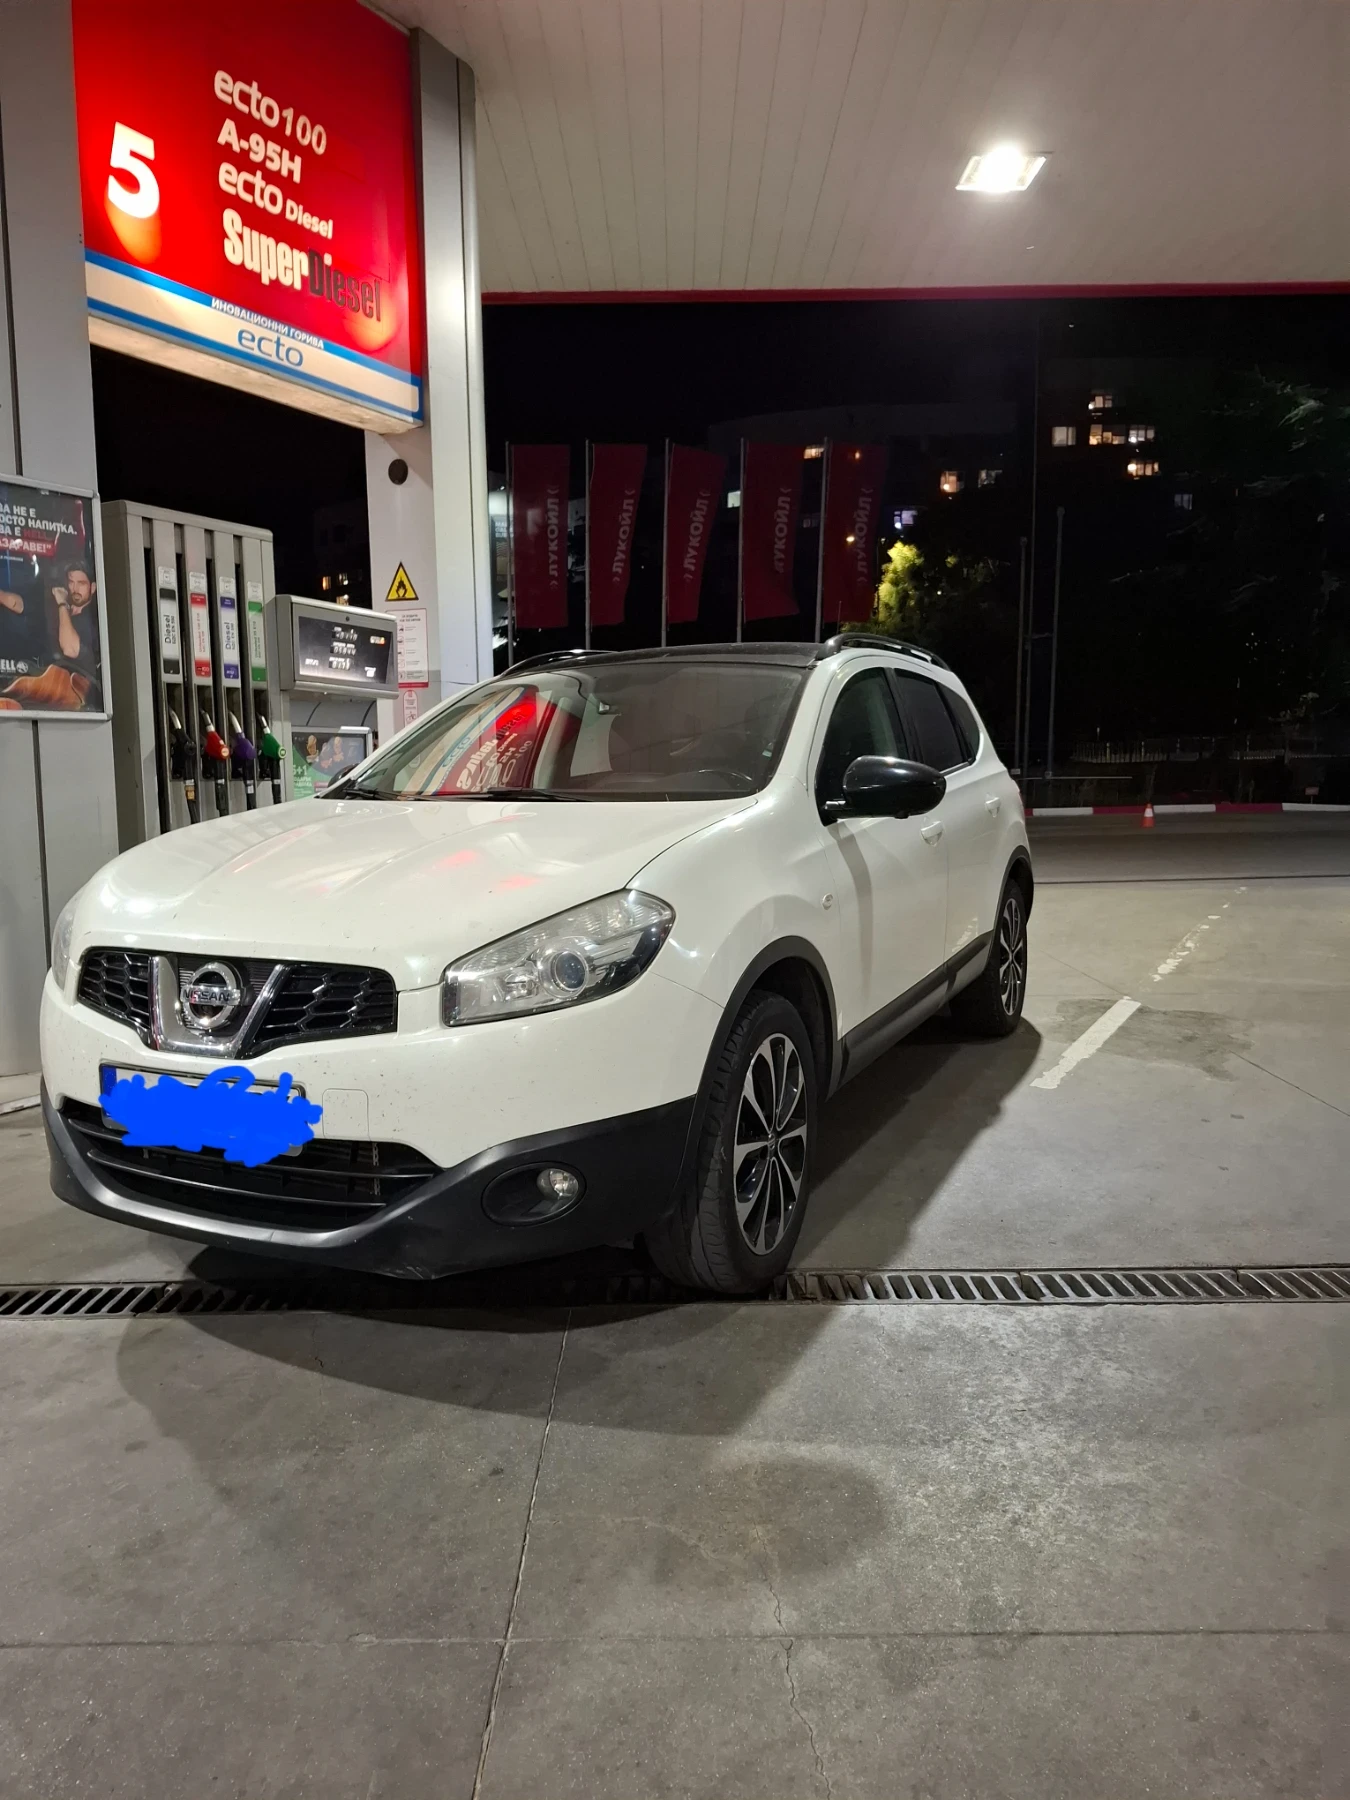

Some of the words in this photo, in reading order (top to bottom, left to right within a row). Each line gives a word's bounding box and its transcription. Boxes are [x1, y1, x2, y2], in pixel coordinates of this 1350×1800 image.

[107, 121, 160, 219] 5
[218, 161, 283, 215] ecto
[285, 198, 333, 240] Diesel
[211, 297, 288, 337] ИНОВАЦИОННИ
[290, 327, 324, 350] ГОРИВА
[237, 328, 304, 367] ecto
[13, 505, 27, 517] НЕ
[29, 508, 36, 518] Е
[15, 526, 21, 537] Е
[28, 518, 77, 535] НАПИТКА.
[683, 498, 709, 571] ЛУКОЙЛ
[545, 497, 560, 578] ЛУКОЙЛ
[611, 498, 635, 574] ЛУКОЙЛ
[163, 614, 172, 644] Diesel
[184, 988, 231, 1002] NISSAN
